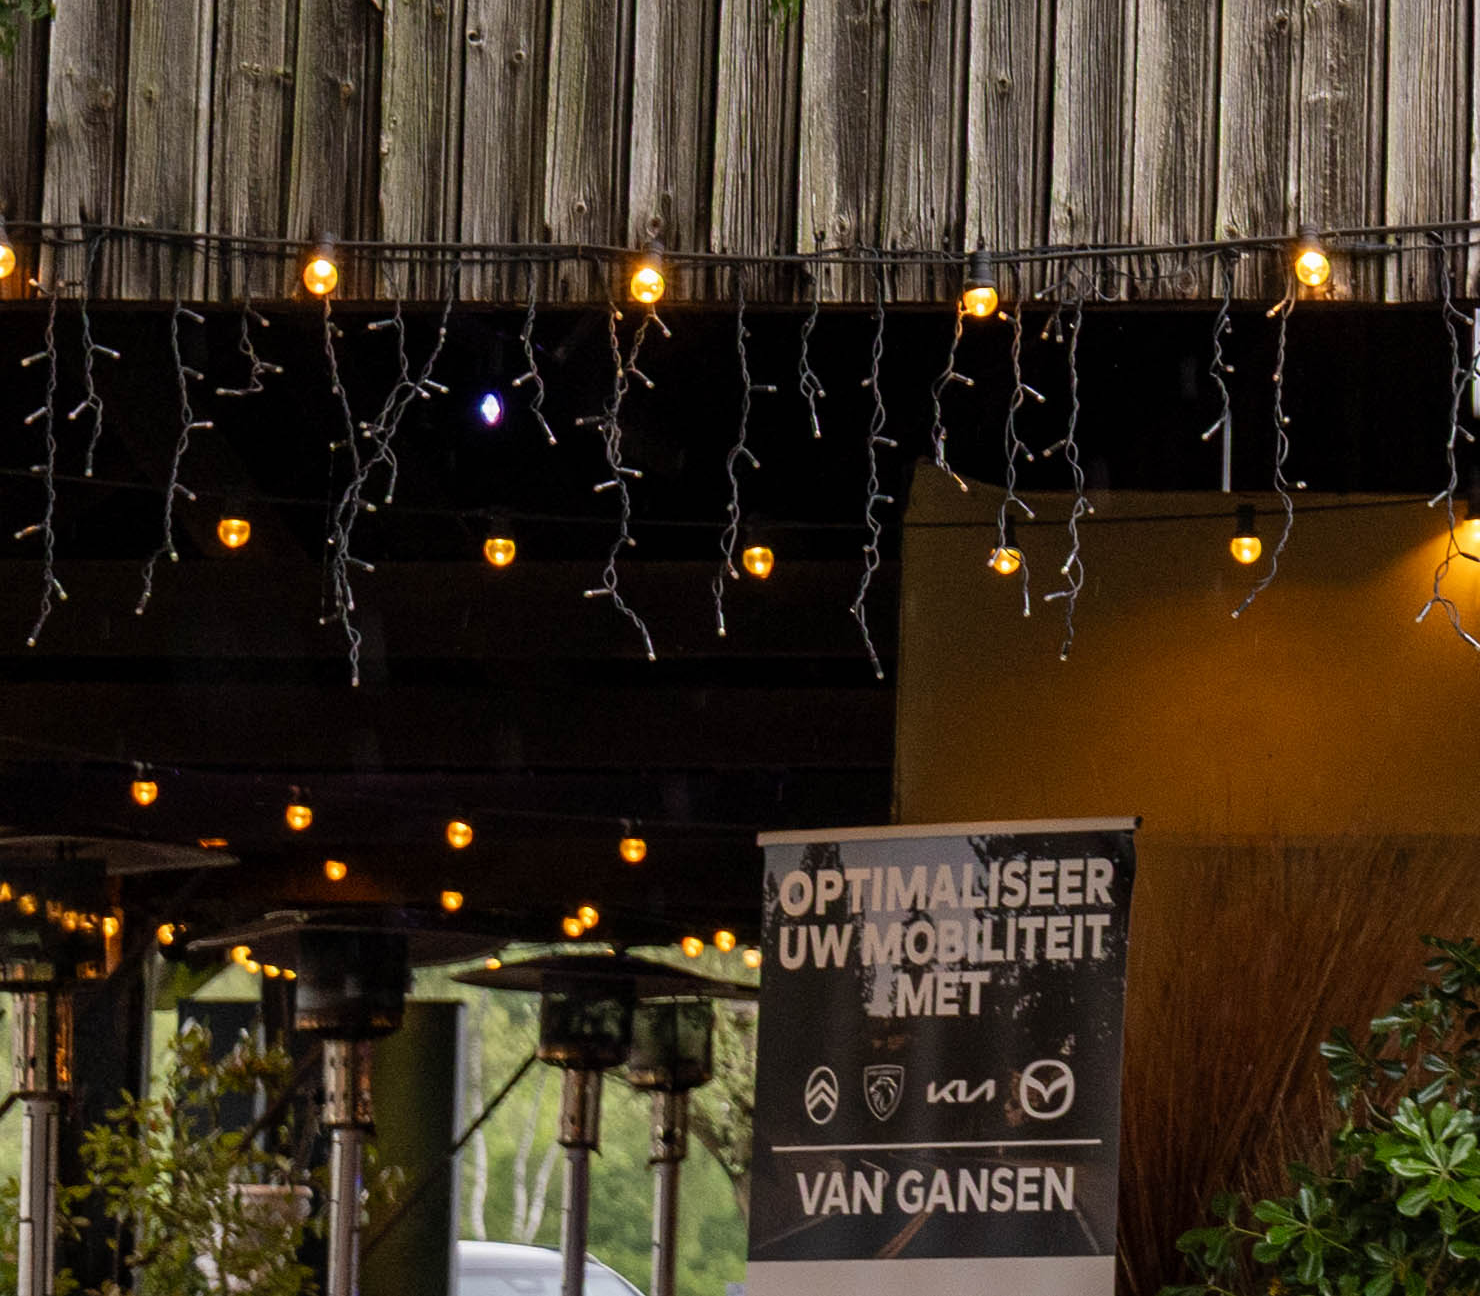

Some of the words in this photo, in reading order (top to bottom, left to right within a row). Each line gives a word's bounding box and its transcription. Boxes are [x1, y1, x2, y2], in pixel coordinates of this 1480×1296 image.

[778, 858, 1115, 917] OPTIMALISEER
[779, 924, 853, 970] UW
[861, 914, 1111, 967] MOBILITEIT
[896, 971, 991, 1018] MET
[796, 1170, 884, 1216] VAN
[896, 1166, 1075, 1214] GANSEN
